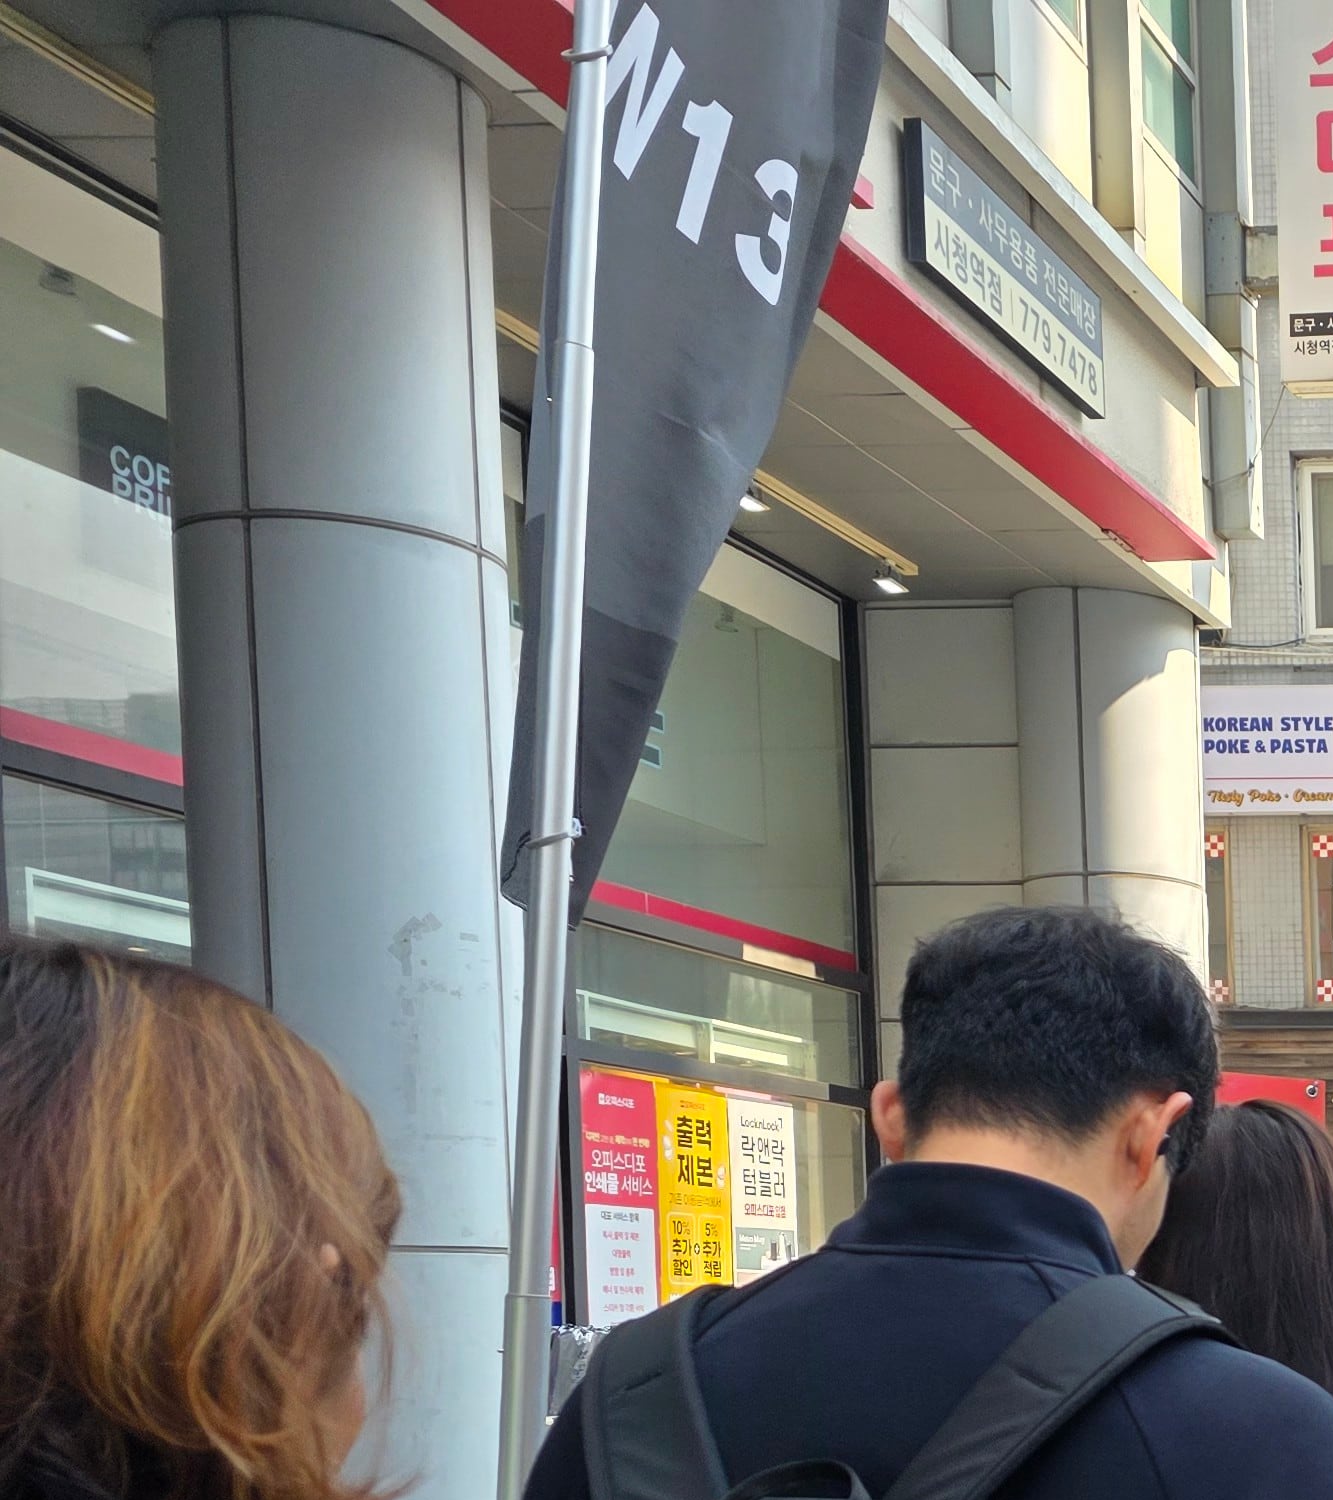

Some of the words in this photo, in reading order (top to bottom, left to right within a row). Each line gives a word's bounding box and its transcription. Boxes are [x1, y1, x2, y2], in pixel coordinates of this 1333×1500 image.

[929, 146, 962, 209] 문구
[979, 200, 1039, 285] 사무용품
[1042, 258, 1097, 341] 전문매장
[935, 218, 1003, 317] 시청역점
[1018, 297, 1098, 396] 779.7478
[1293, 318, 1316, 333] 문구
[112, 473, 172, 520] PRI
[1202, 716, 1273, 732] KOREAN
[1280, 715, 1333, 731] STYLE
[1203, 738, 1250, 754] POKE
[1254, 740, 1267, 753] &
[1270, 738, 1329, 754] PASTA
[1207, 789, 1245, 807] Tasty
[1247, 788, 1281, 802] Poke
[676, 1115, 712, 1151] 출력
[591, 1149, 647, 1173] 오피스디포
[741, 1135, 785, 1167] 락앤락
[676, 1154, 713, 1187] 제본
[584, 1171, 619, 1195] 인쇄물
[621, 1174, 654, 1197] 서비스
[743, 1168, 786, 1198] 텀블러
[744, 1203, 775, 1217] 오피스디포
[672, 1220, 691, 1235] 10%
[705, 1223, 718, 1237] 5%
[672, 1238, 692, 1256] 추가
[702, 1240, 722, 1258] 추가
[672, 1258, 693, 1277] 할인
[703, 1260, 722, 1278] 적립
